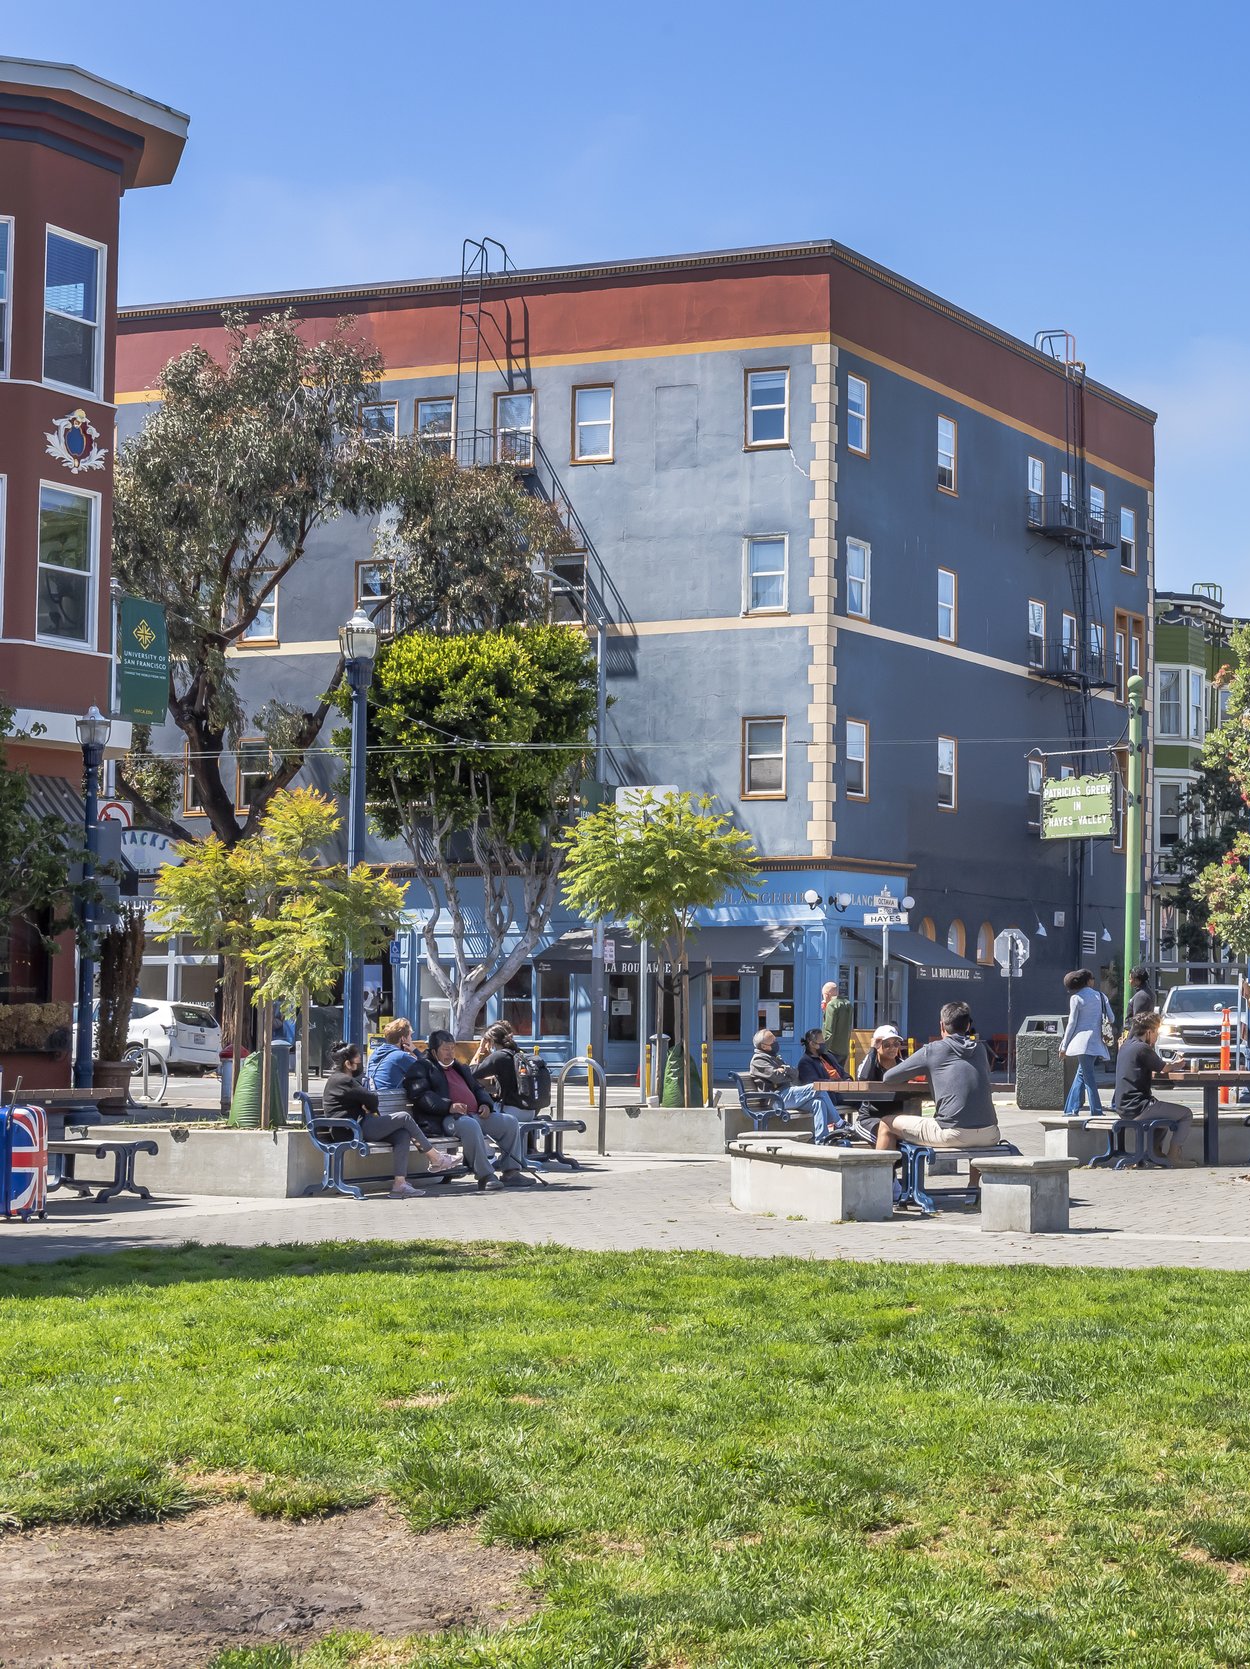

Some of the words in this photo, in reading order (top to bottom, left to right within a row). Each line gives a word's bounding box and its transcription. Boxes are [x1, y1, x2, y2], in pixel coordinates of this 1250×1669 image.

[123, 650, 157, 660] UNIVERSITY
[136, 660, 167, 670] FRANCISCO
[1086, 784, 1111, 796] GREEN
[1073, 801, 1081, 811] IN
[1049, 816, 1073, 827] HAYES
[1078, 814, 1108, 825] VALLEY
[870, 914, 901, 922] HAYES
[604, 962, 617, 973] LA
[931, 967, 938, 978] LA
